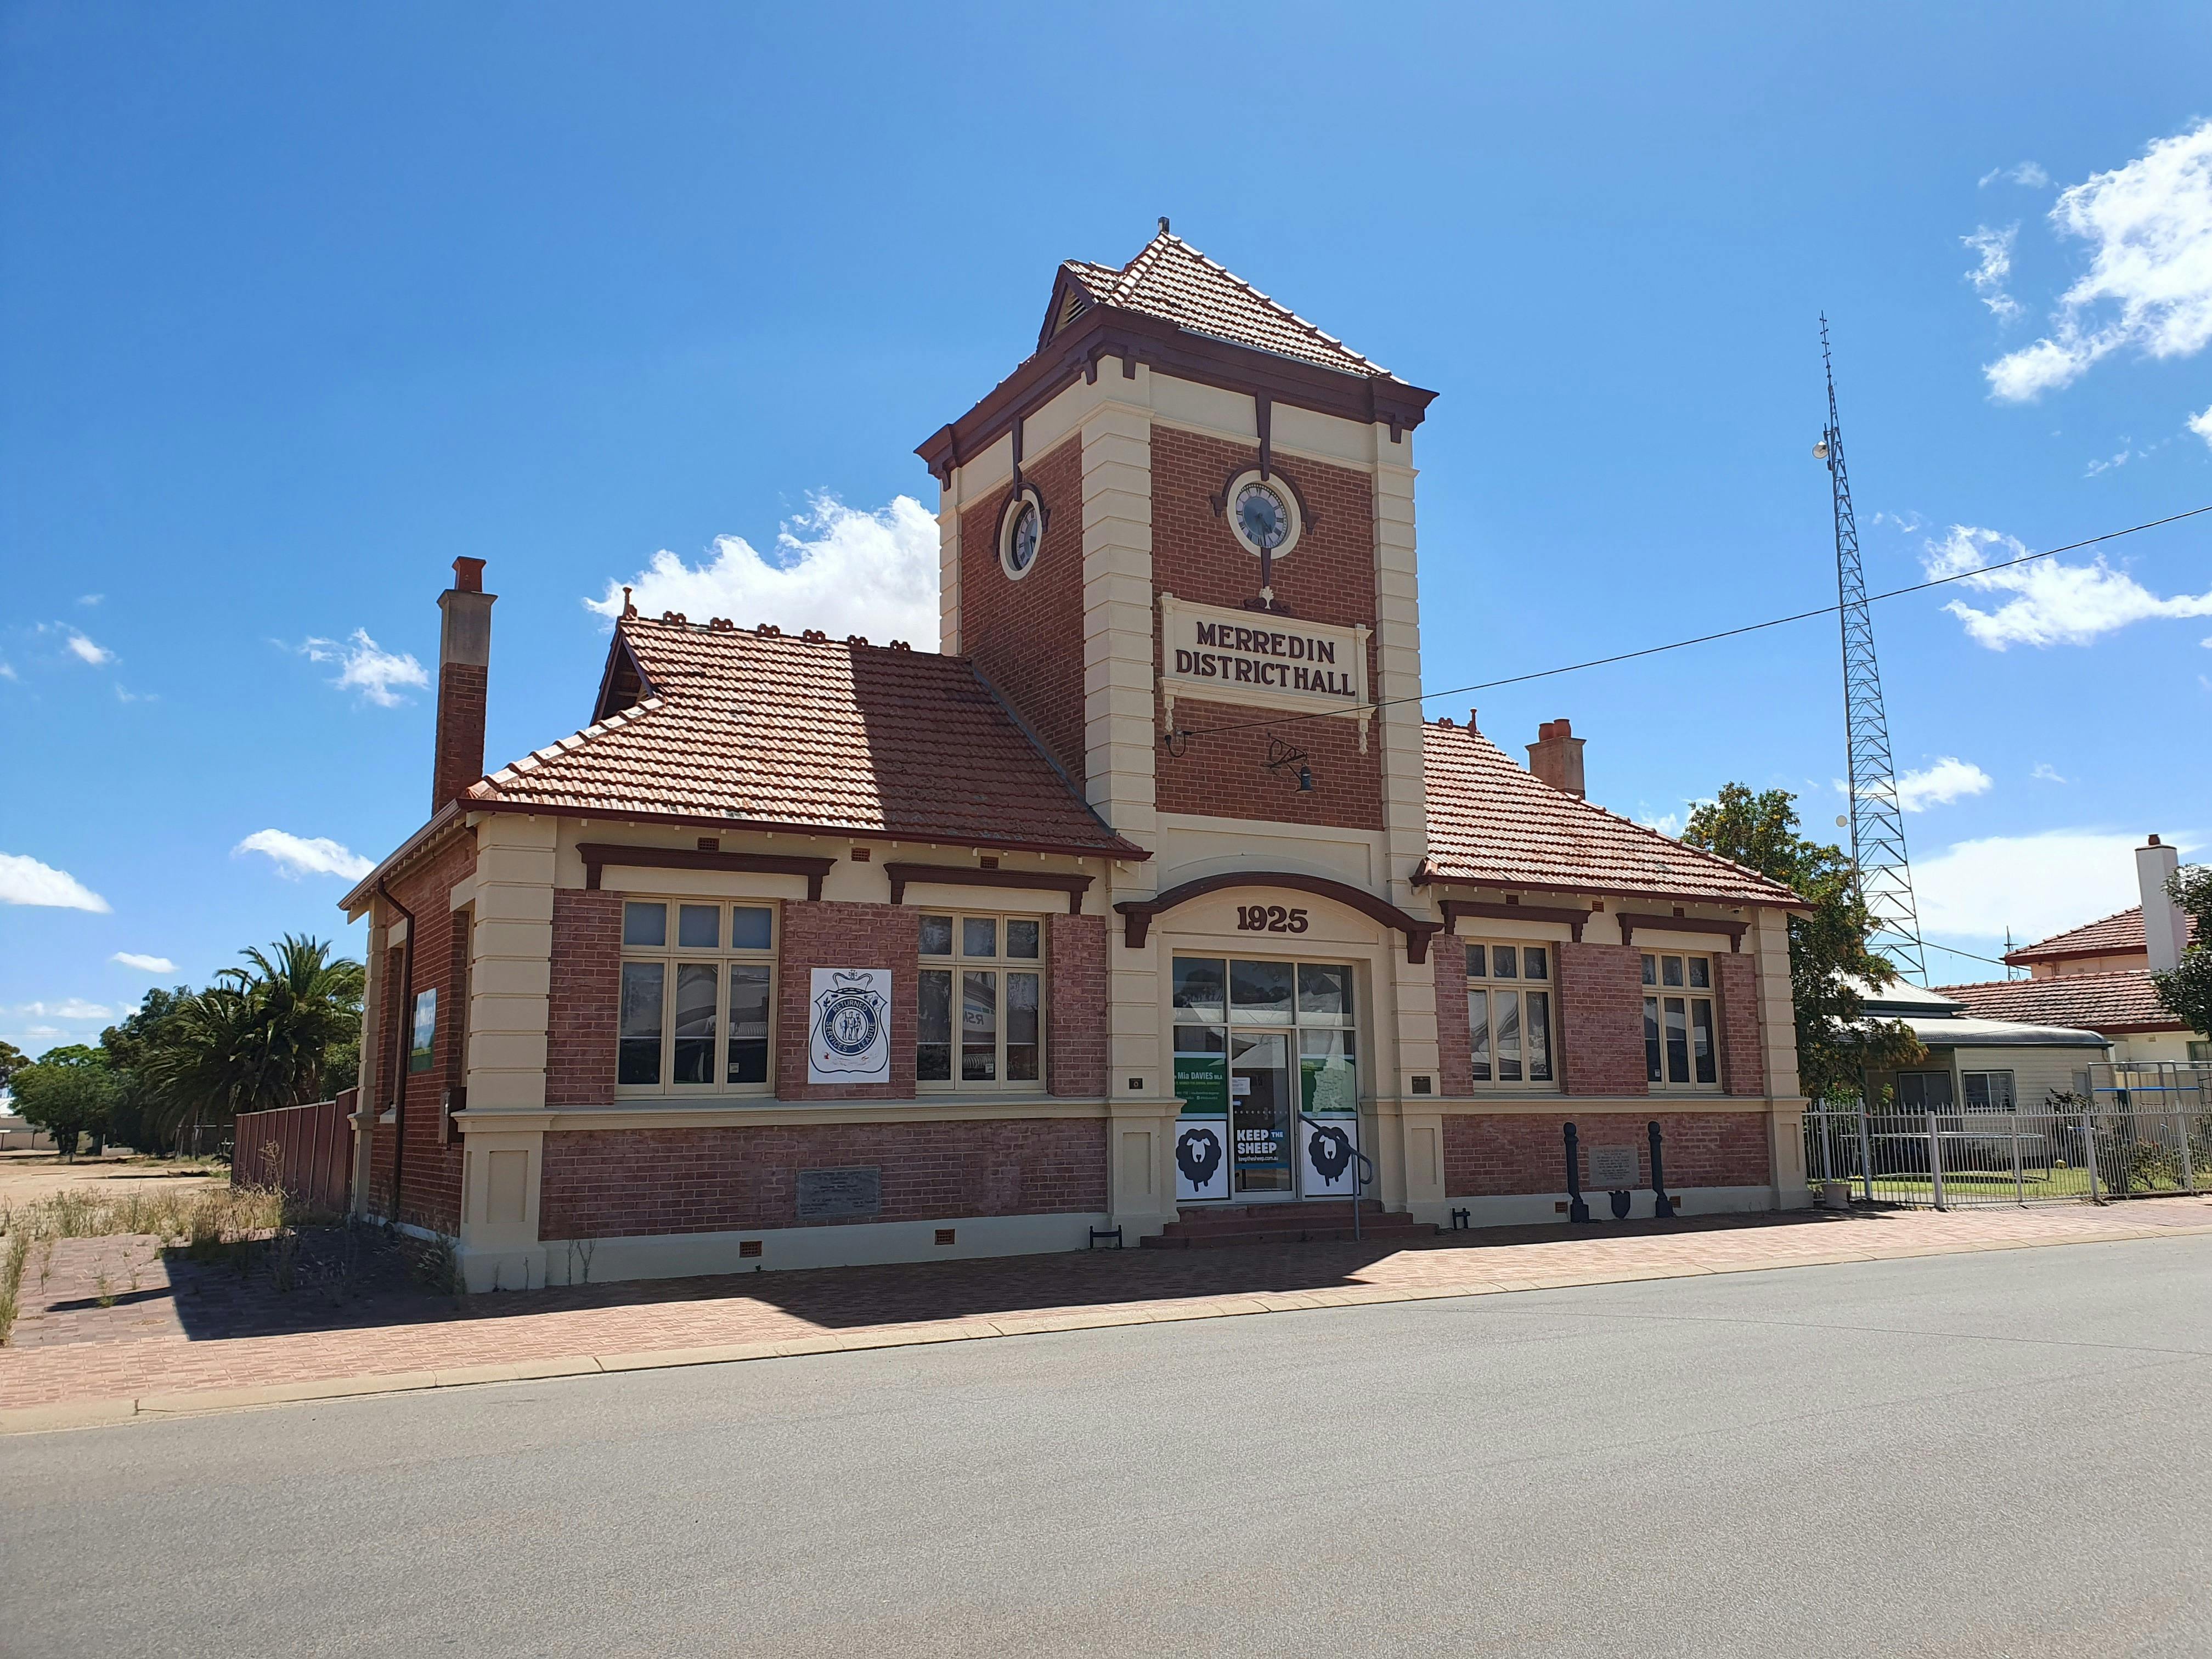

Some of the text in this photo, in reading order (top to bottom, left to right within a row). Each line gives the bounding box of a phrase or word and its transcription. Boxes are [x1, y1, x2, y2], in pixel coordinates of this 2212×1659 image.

[1196, 622, 1335, 664] MERREDIN
[1176, 650, 1356, 696] DISTRICT HALL
[1237, 905, 1308, 933] 1925
[832, 998, 868, 1013] RETURNED
[826, 1022, 848, 1052] SERVICES
[857, 1022, 875, 1049] LEAGUE
[1191, 1071, 1213, 1080] DAVIES
[1237, 1129, 1269, 1141] KEEP
[1237, 1142, 1277, 1154] SHEEP
